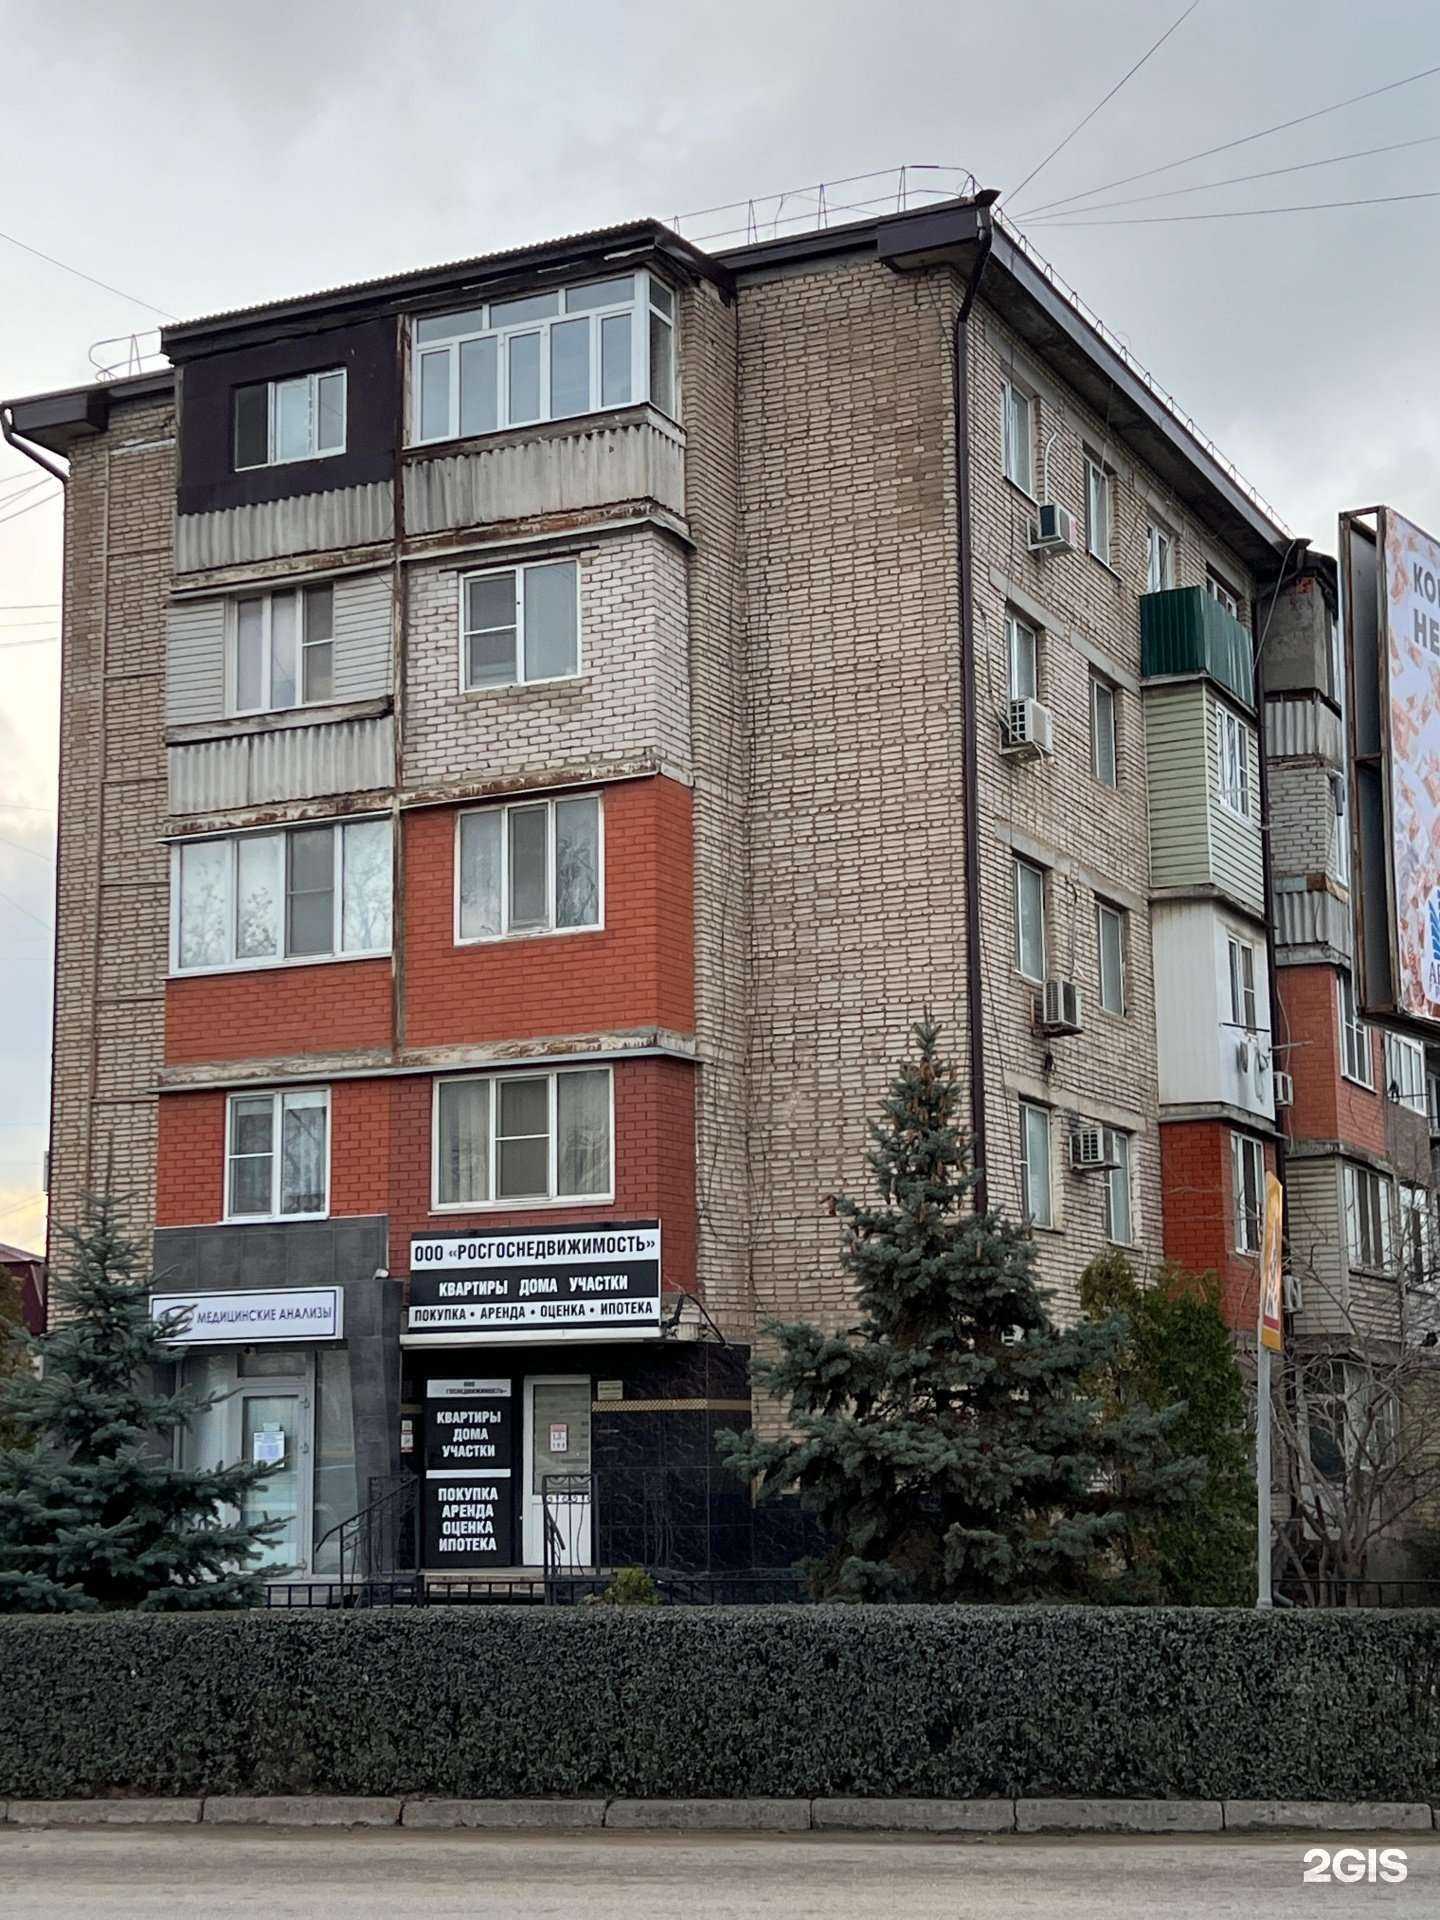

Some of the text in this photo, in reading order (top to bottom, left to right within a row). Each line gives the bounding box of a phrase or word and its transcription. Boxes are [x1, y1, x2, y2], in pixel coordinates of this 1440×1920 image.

[1413, 561, 1440, 608] КО
[414, 1235, 656, 1262] ООО «РОСГОСНЕДВИЖИМОСТЬ»
[438, 1275, 628, 1297] КВАРТИРЫ ДОМА УЧАСТКИ
[197, 1306, 332, 1324] МЕДИЦИНСКИЕ АНАЛИЗЫ
[414, 1301, 653, 1322] ПОКУПКА АРЕНДА ОЦЕНКА ИПОТЕКА
[437, 1411, 501, 1424] КВАРТИРЫ
[453, 1428, 489, 1442] ДОМА
[442, 1445, 496, 1458] УЧАСТКИ
[438, 1487, 499, 1502] ПОКУПКА
[442, 1504, 494, 1519] АРЕНДА
[442, 1521, 494, 1537] ОЦЕНКА
[439, 1538, 497, 1552] ИПОТЕКА
